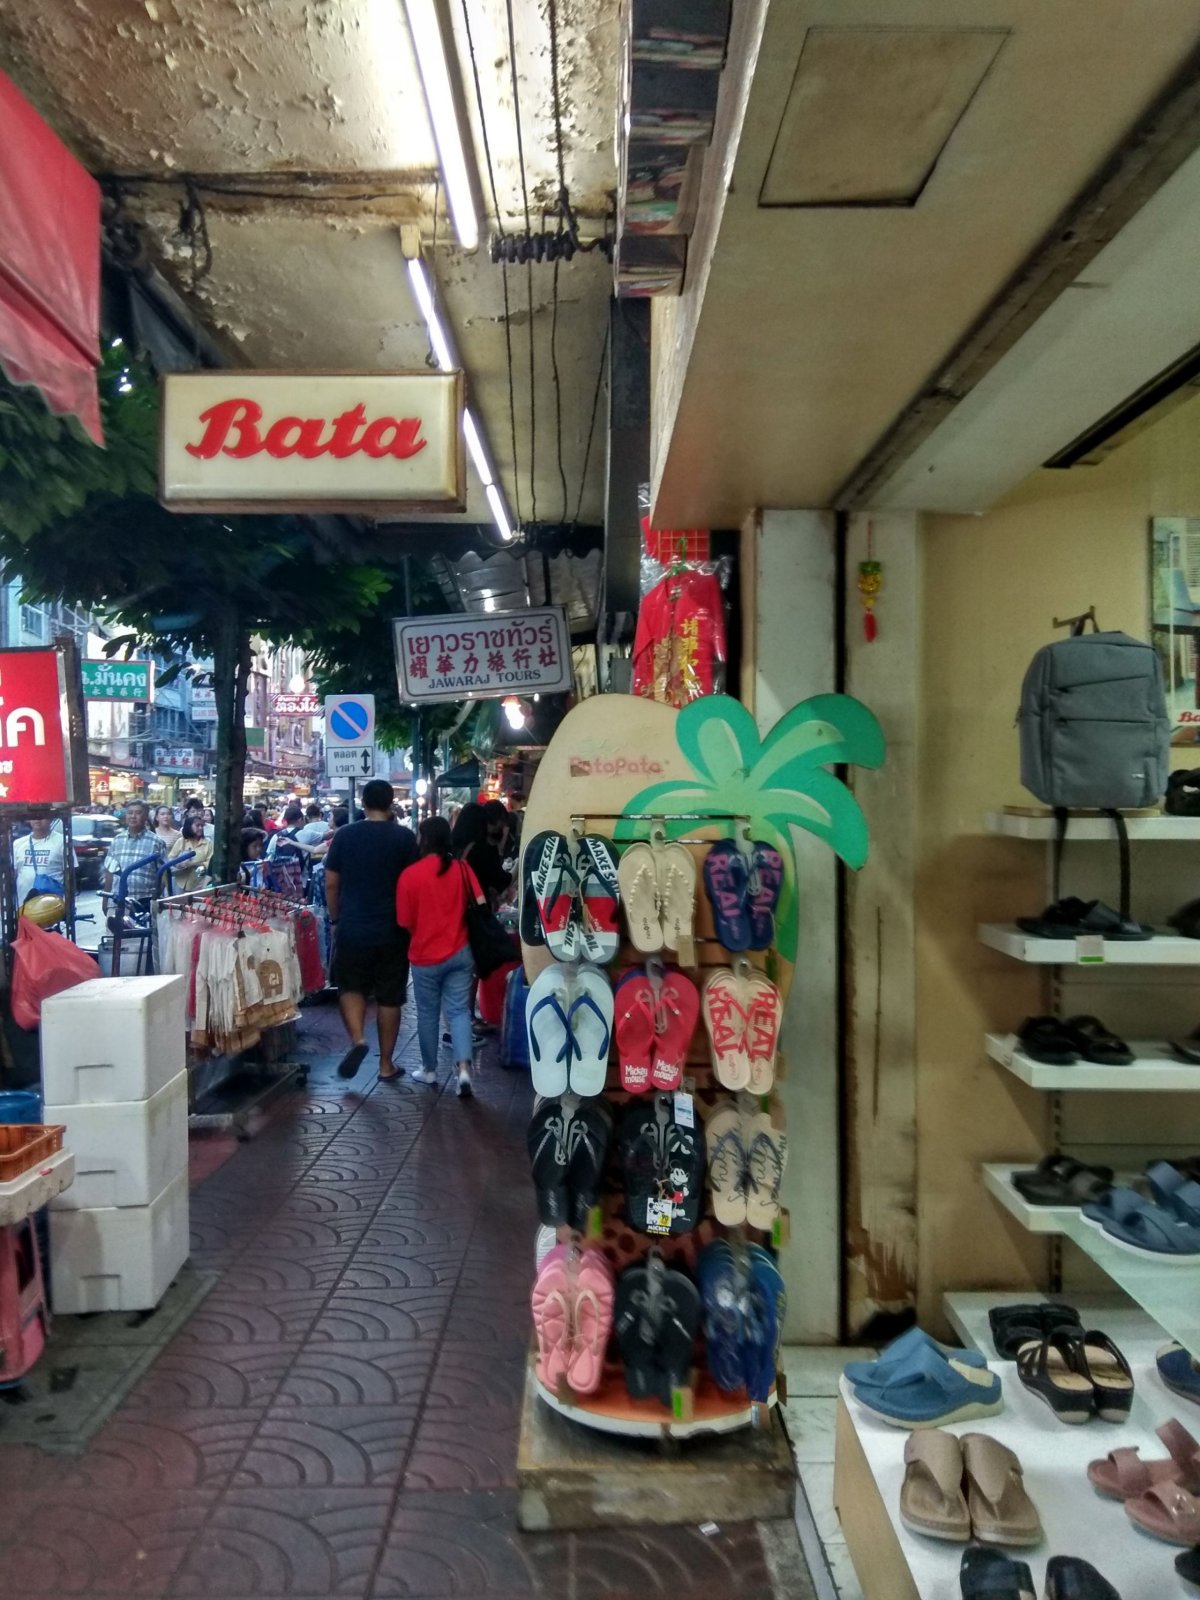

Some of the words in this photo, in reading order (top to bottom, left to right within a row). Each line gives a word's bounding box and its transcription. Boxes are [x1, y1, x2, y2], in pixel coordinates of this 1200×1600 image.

[185, 398, 427, 459] Bata
[407, 619, 553, 656] เยาวราชทัวร์
[409, 645, 558, 679] 耀華力旅行社
[428, 674, 490, 689] JAWARAJ
[498, 669, 541, 683] TOURS
[588, 837, 611, 871] MAKE
[535, 861, 550, 896] MAKE
[564, 921, 577, 948] SAIL
[625, 1065, 648, 1077] Mickey
